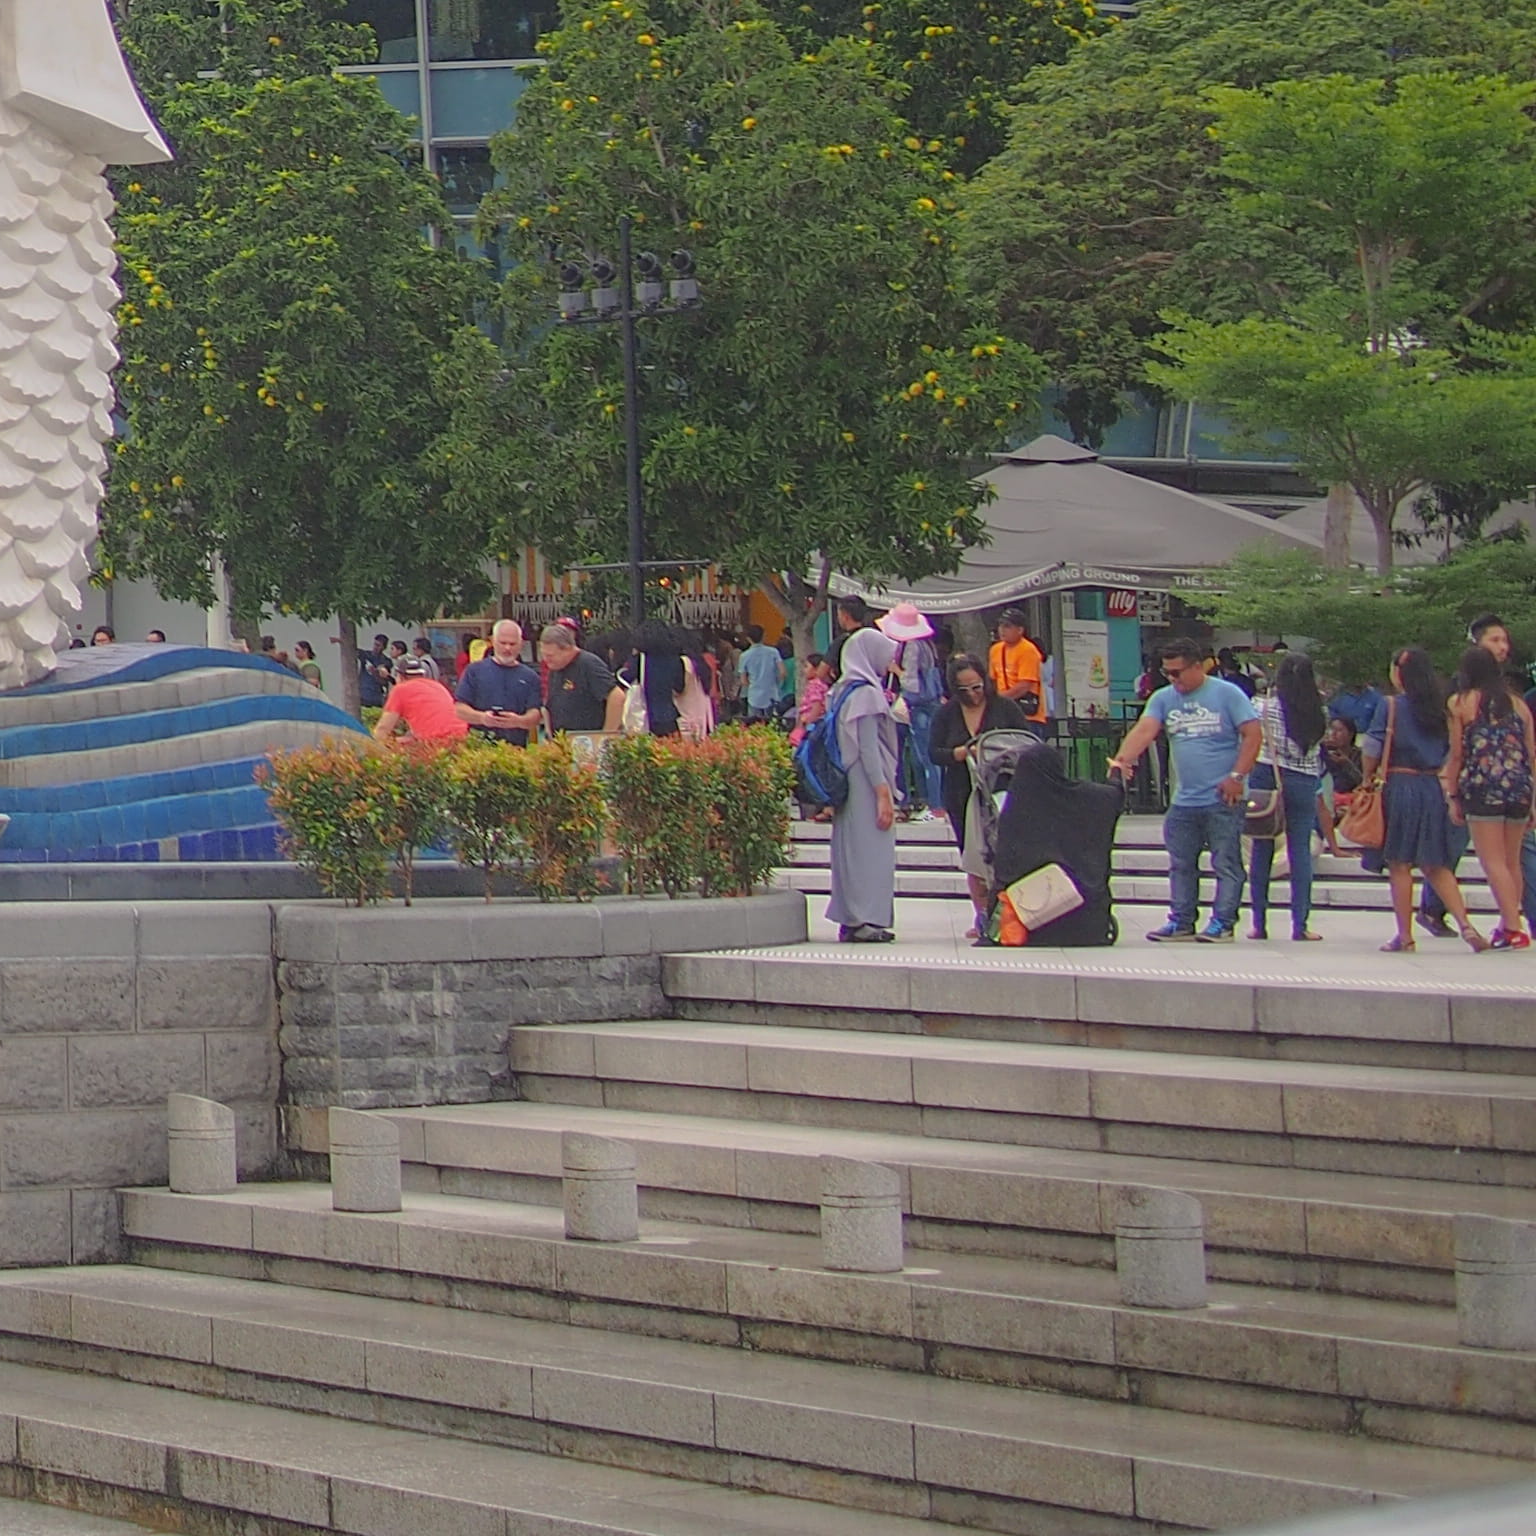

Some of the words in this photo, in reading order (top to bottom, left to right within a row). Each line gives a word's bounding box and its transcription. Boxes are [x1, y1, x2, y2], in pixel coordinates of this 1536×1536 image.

[1017, 568, 1081, 592] STOMPING
[1082, 568, 1141, 584] GROUND
[1174, 575, 1201, 587] THE
[1108, 590, 1136, 615] illy
